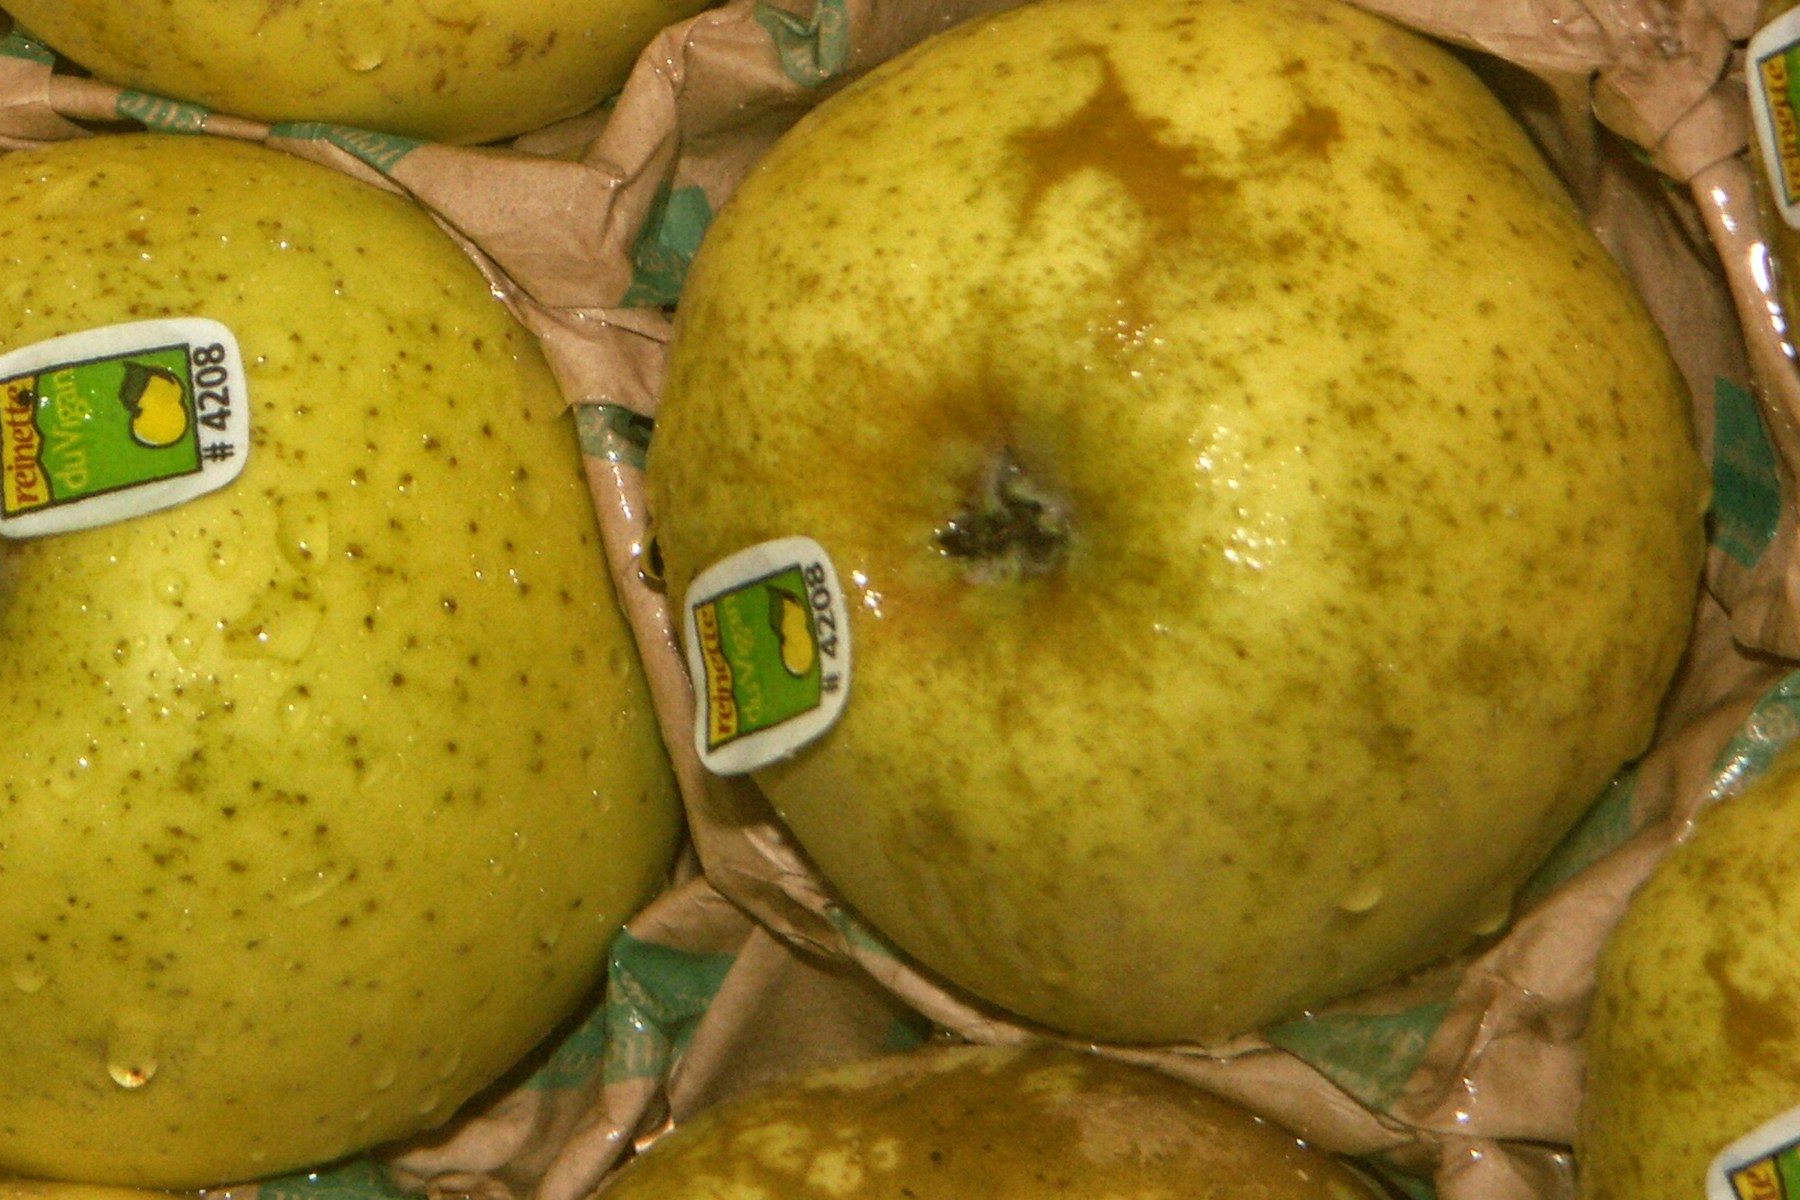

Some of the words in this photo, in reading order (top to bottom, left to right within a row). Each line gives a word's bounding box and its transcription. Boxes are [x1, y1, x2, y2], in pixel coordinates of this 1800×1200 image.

[192, 342, 233, 432] 4208
[201, 441, 235, 463] #
[804, 561, 839, 660] 4208
[701, 610, 732, 735] reinette
[821, 671, 841, 693] #
